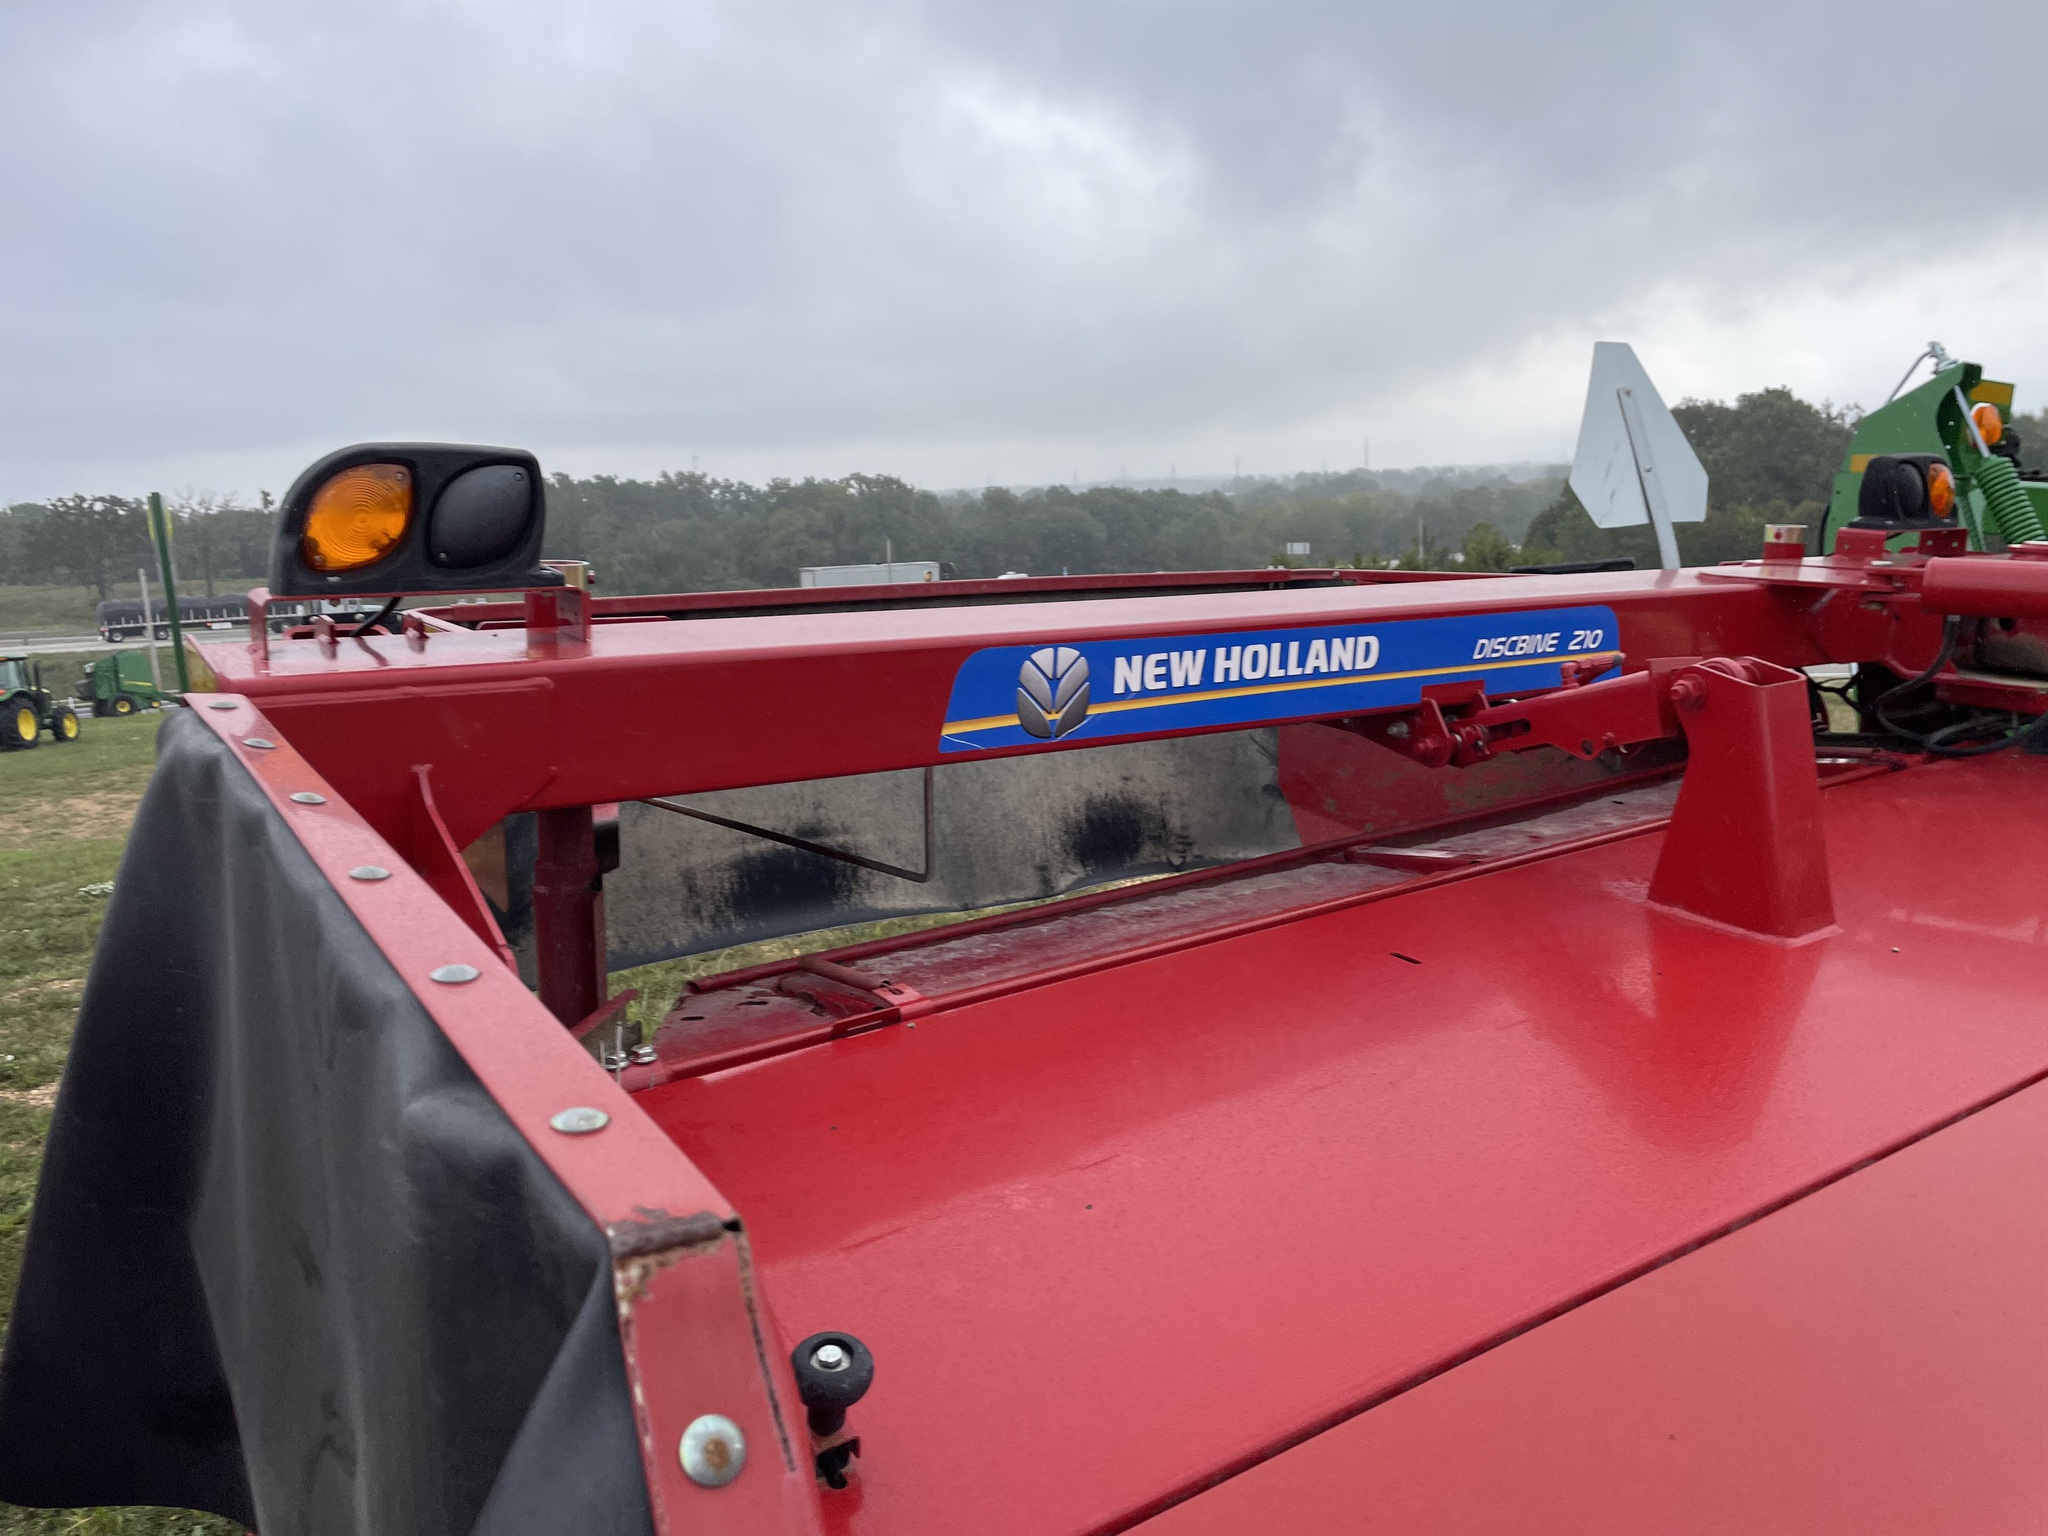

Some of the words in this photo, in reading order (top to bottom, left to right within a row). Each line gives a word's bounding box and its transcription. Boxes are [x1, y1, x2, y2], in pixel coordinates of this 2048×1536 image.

[1113, 649, 1207, 694] NEW
[1213, 635, 1380, 683] HOLLAND
[1472, 632, 1561, 660] DISCBINE
[1567, 629, 1604, 651] 210
